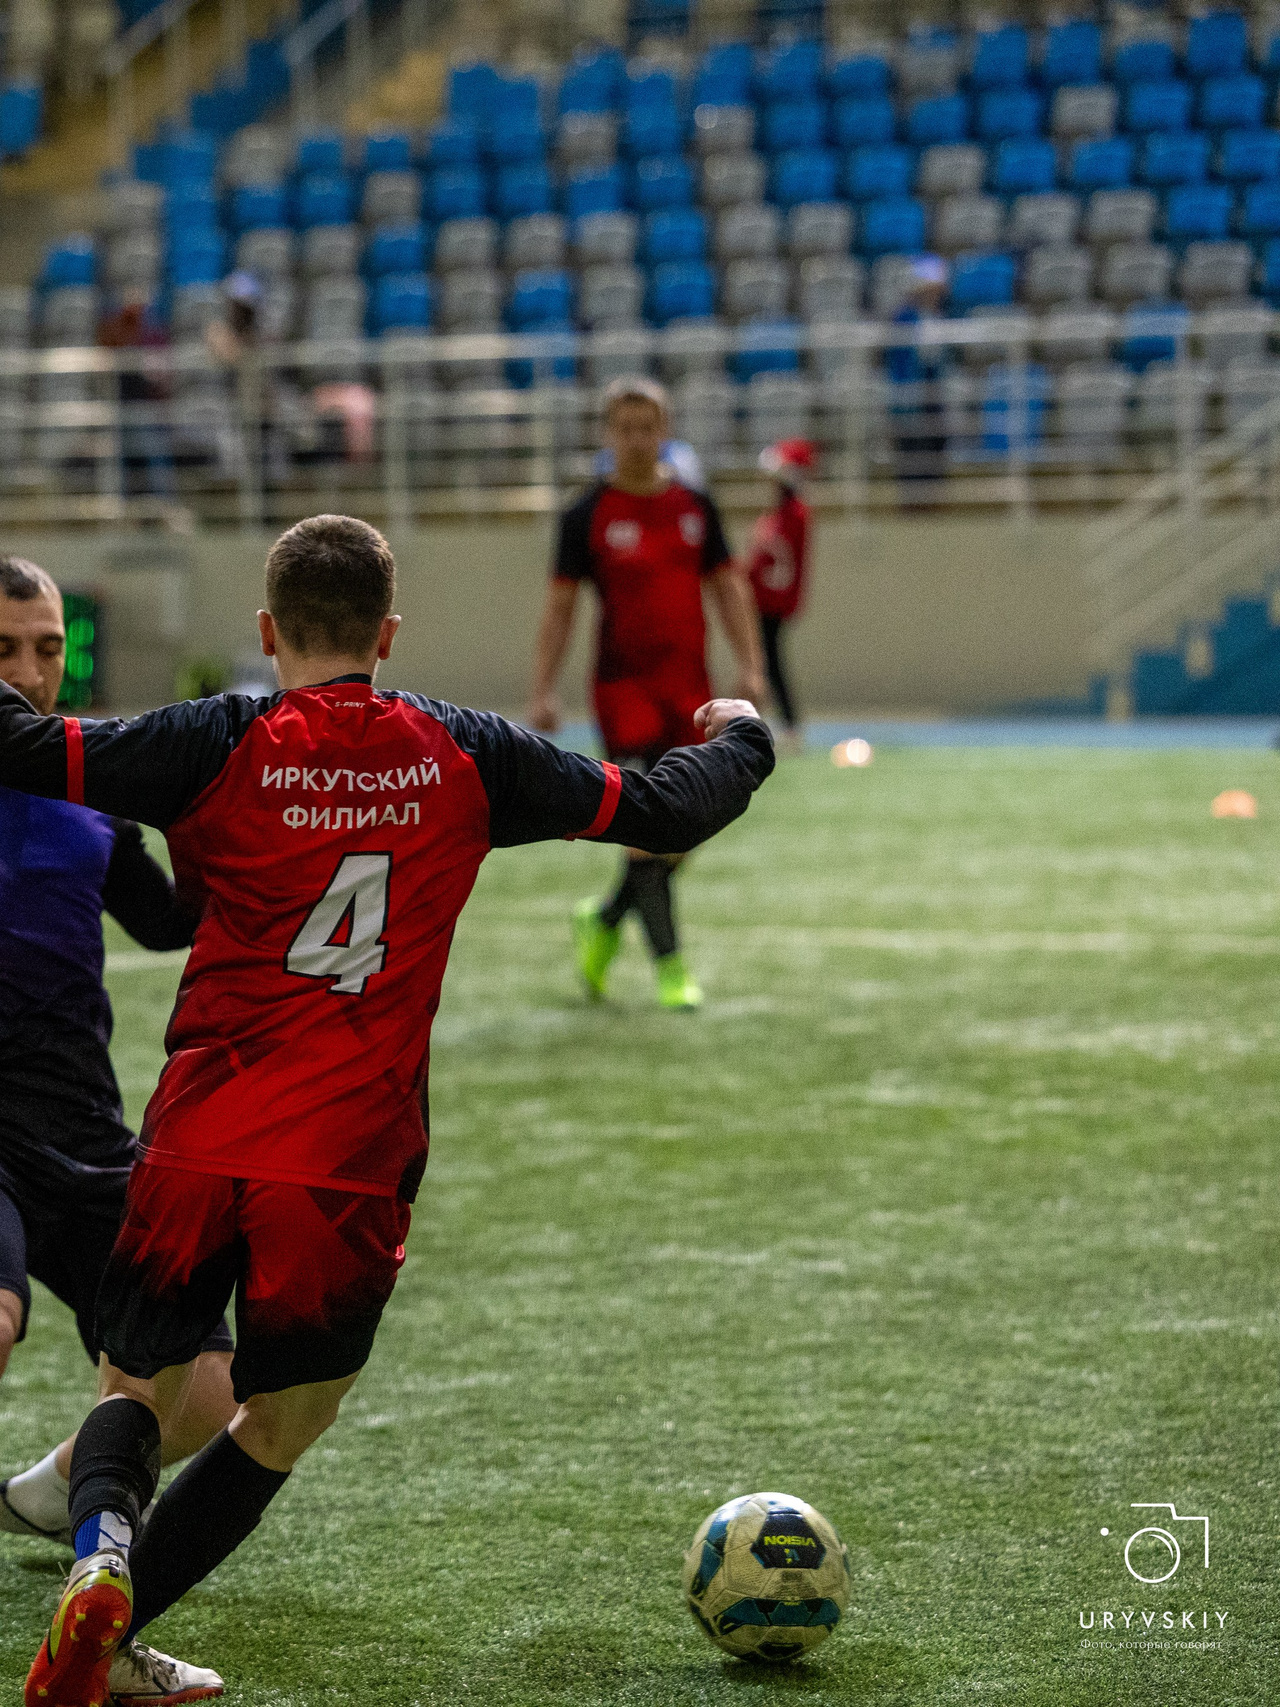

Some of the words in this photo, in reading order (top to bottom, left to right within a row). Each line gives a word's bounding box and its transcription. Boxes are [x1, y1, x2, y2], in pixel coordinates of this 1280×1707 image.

[334, 701, 366, 709] S-PRINT
[261, 757, 442, 792] ИРКУТСКИЙ
[282, 802, 421, 830] ФИЛИАЛ
[283, 851, 393, 996] 4
